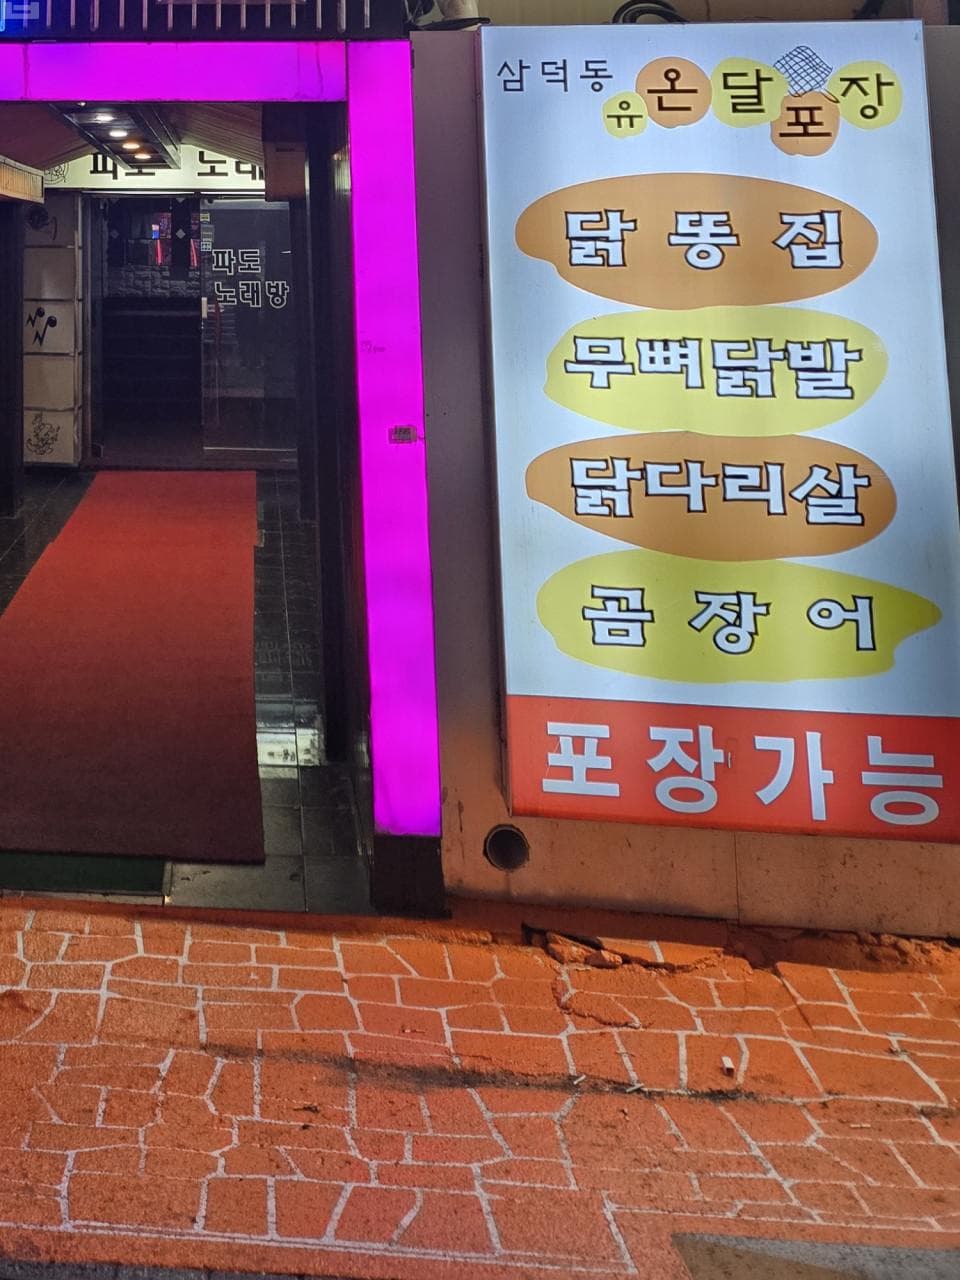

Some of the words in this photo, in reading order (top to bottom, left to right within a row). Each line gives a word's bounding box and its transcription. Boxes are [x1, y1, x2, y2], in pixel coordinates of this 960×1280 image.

[496, 58, 613, 93] 삼덕동
[212, 249, 262, 275] 파도
[214, 280, 289, 308] 노래방
[569, 456, 871, 526] 닭다리살
[582, 584, 877, 655] 곰장어
[541, 720, 944, 826] 포장가능
